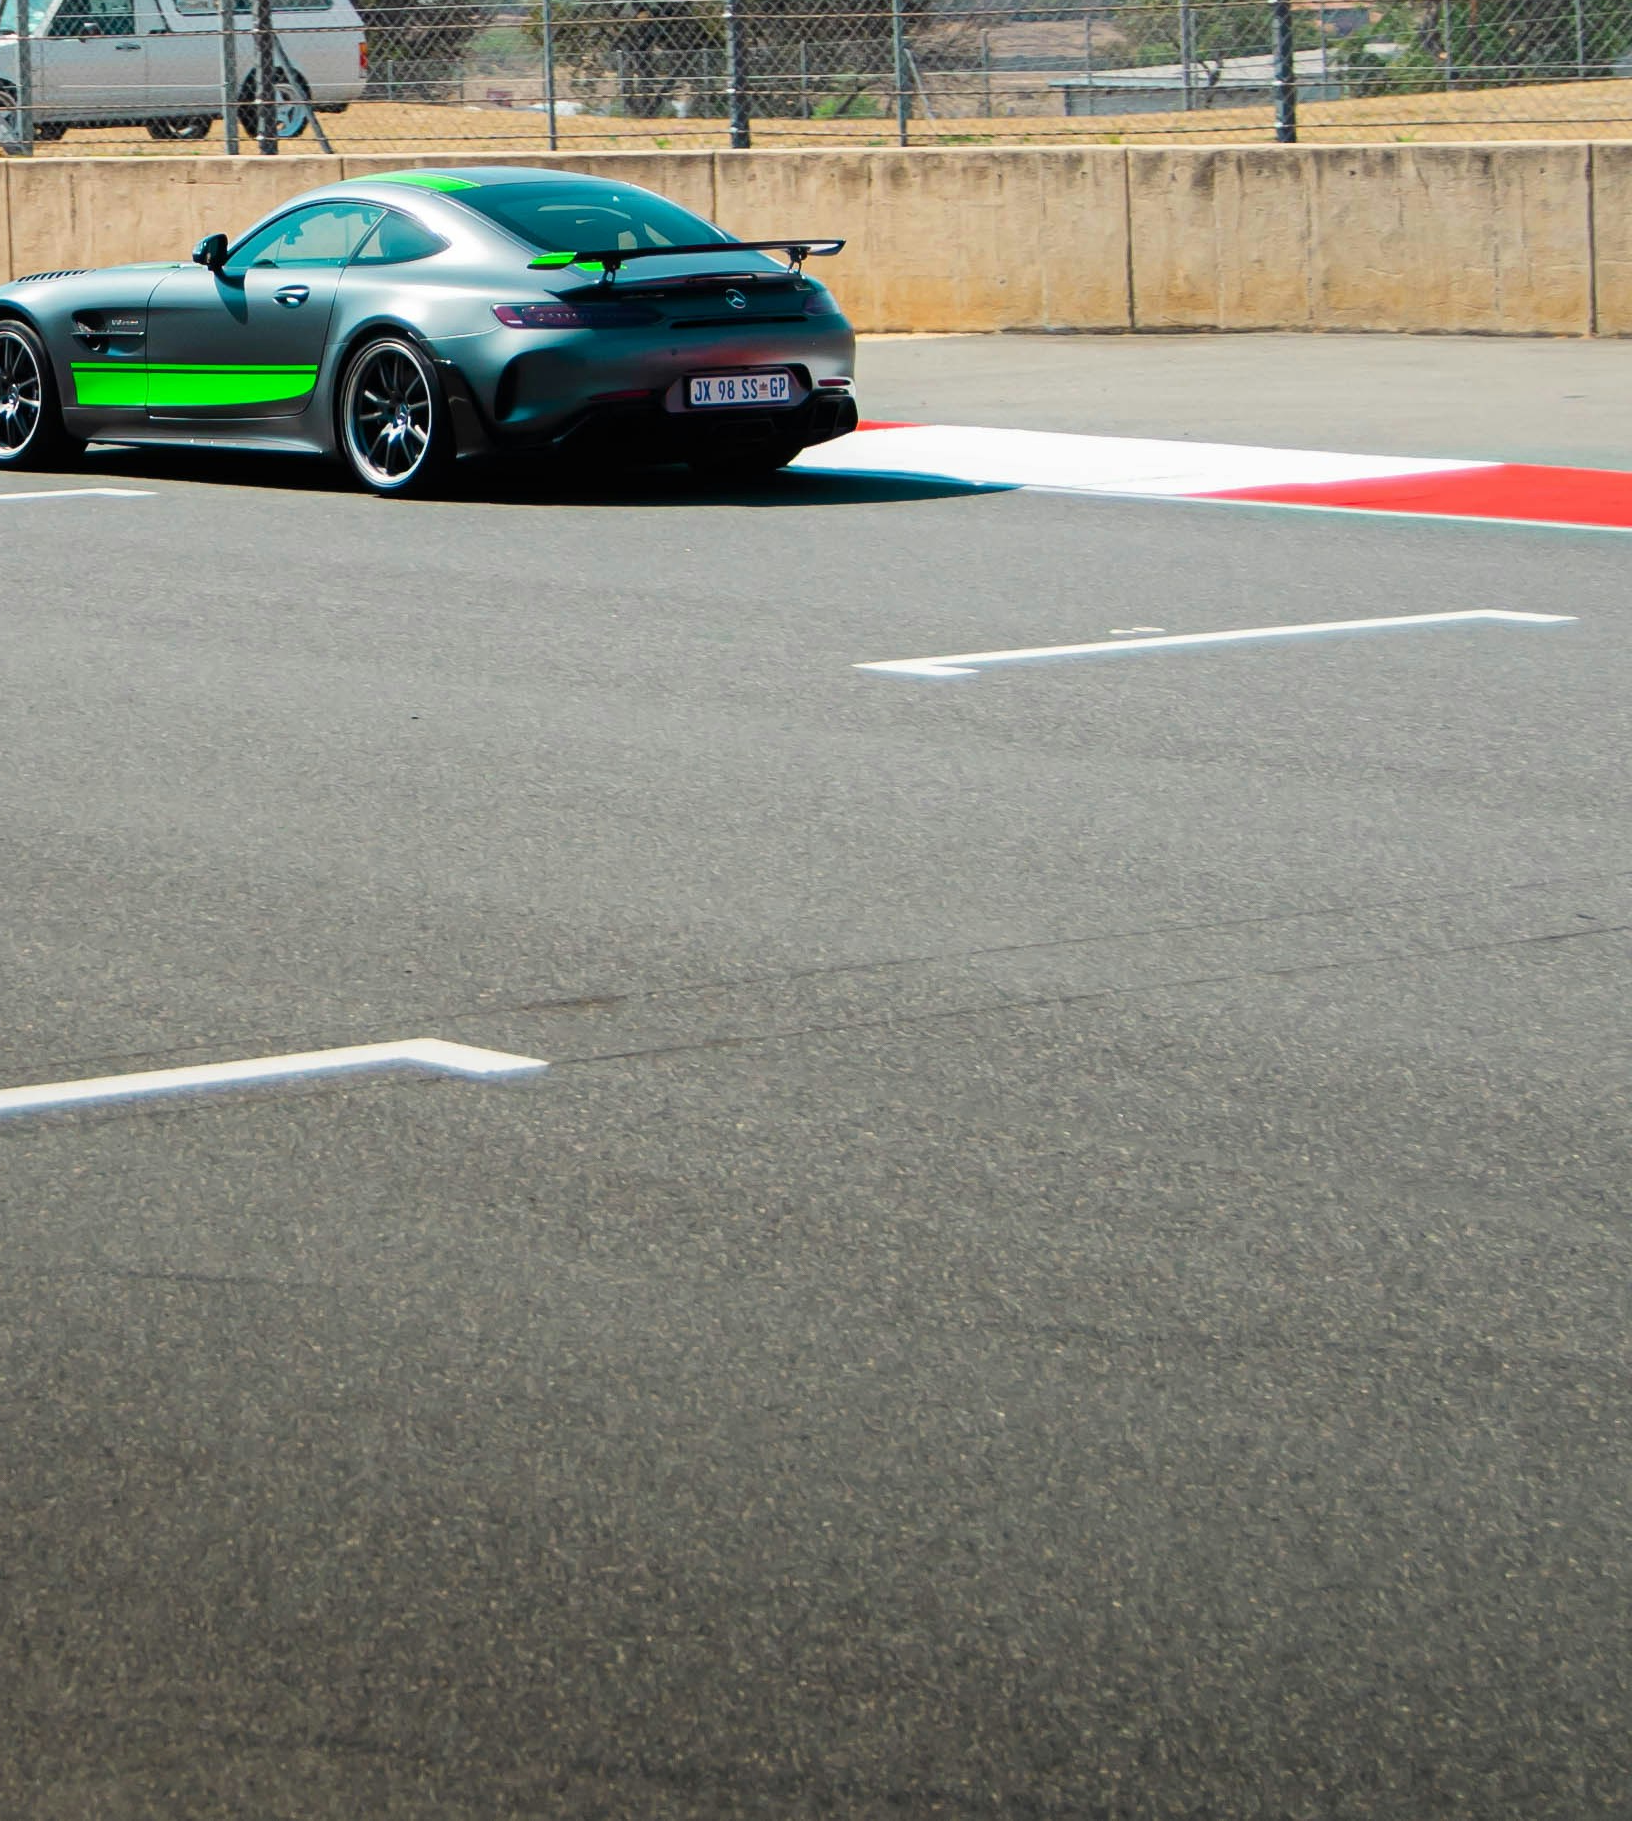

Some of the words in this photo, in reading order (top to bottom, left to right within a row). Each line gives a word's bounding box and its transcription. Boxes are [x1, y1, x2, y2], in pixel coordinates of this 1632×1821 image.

[695, 380, 711, 401] JX
[718, 380, 735, 400] 98
[742, 378, 758, 399] SS
[770, 377, 785, 397] GP
